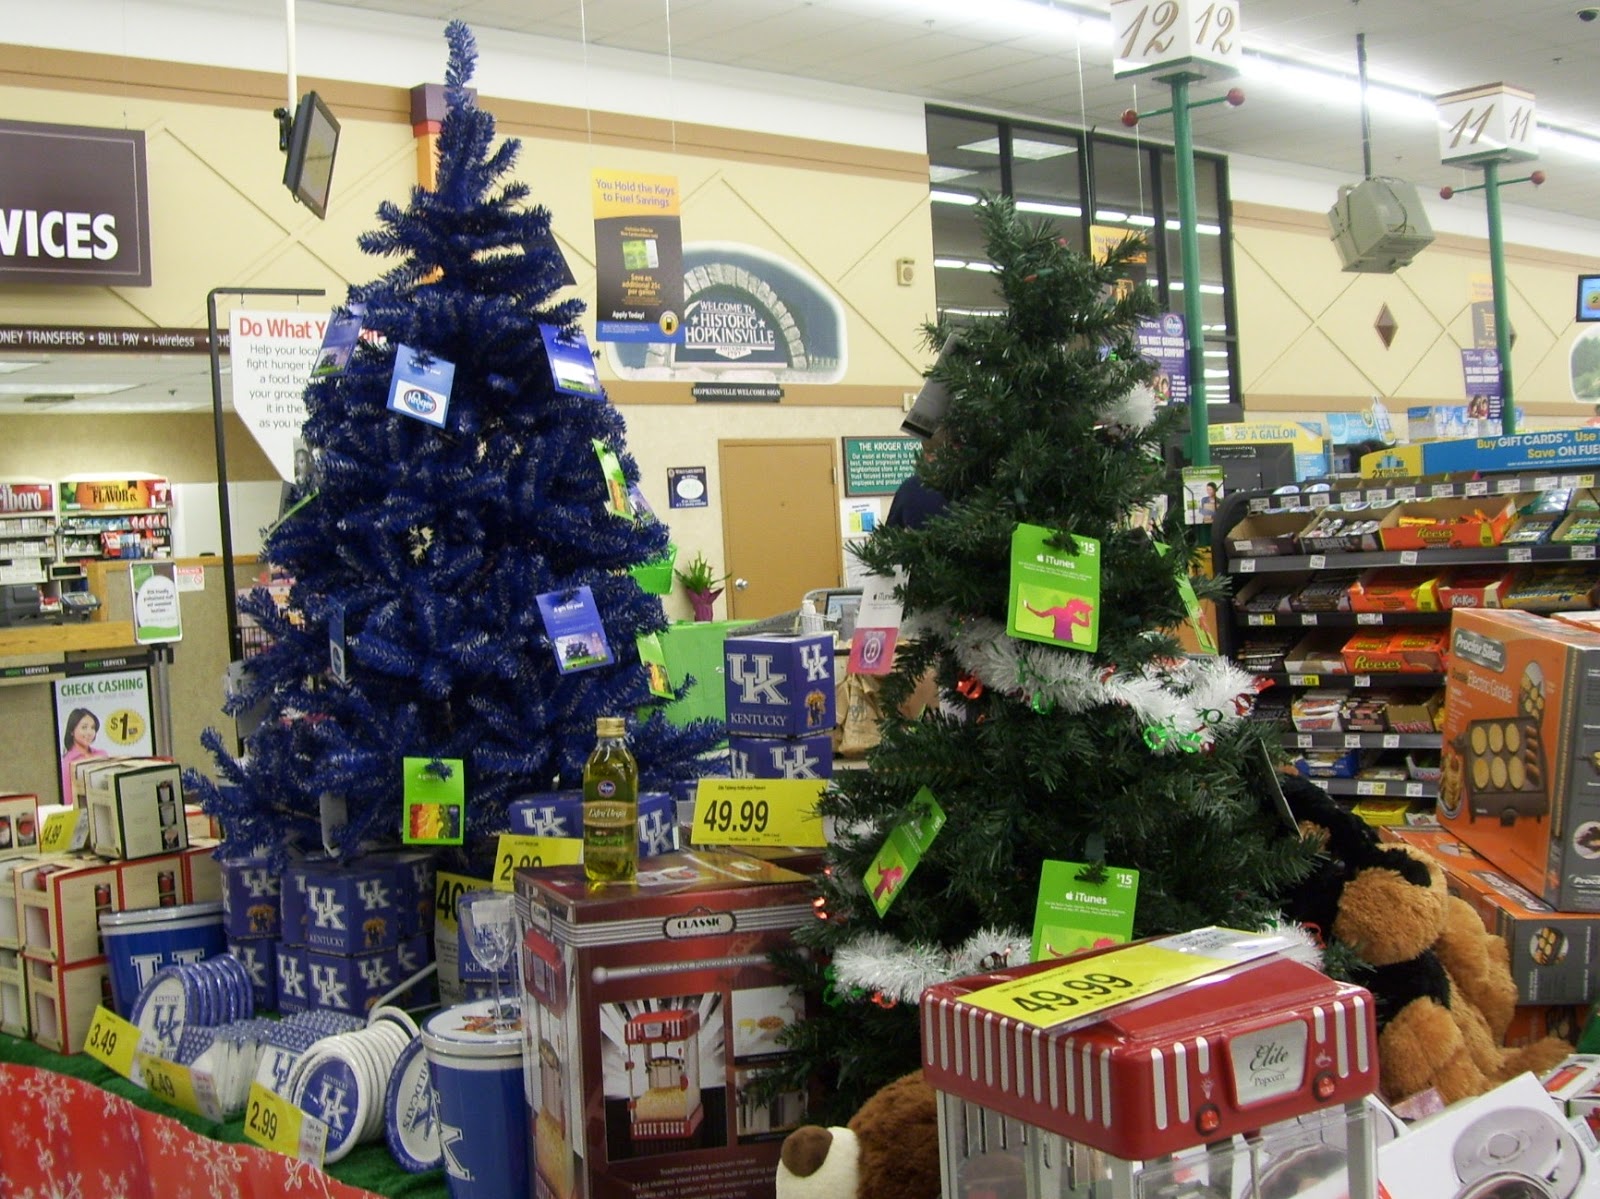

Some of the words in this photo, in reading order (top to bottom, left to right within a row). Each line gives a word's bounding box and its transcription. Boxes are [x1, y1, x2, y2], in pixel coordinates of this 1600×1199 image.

[1121, 0, 1179, 58] 12
[1195, 3, 1235, 54] 12
[1448, 103, 1495, 149] 11
[1509, 106, 1532, 142] 11
[596, 178, 613, 190] You
[614, 180, 635, 192] Hold
[638, 183, 652, 193] the
[655, 184, 674, 197] Keys
[603, 193, 613, 202] to
[615, 193, 634, 203] Fuel
[636, 194, 669, 208] Savings
[612, 311, 627, 320] Apply
[700, 300, 742, 312] WELCOME
[743, 304, 755, 313] TO
[239, 317, 263, 337] Do
[266, 318, 312, 339] What
[700, 313, 758, 329] HISTORIC
[27, 331, 86, 346] TRANSFERS
[98, 332, 120, 346] BILL
[122, 333, 140, 347] PAY
[685, 326, 775, 344] HOPKINSVILLE
[250, 344, 272, 355] Help
[274, 347, 296, 356] your
[246, 359, 268, 370] fight
[271, 359, 305, 371] hunger
[268, 373, 290, 383] food
[249, 389, 271, 400] your
[693, 387, 737, 396] HOPKINSVILLE
[737, 388, 767, 396] WELCOME
[275, 404, 284, 413] in
[286, 405, 303, 414] the
[406, 390, 435, 412] Kroger
[258, 419, 271, 427] as
[273, 420, 291, 430] you
[1259, 428, 1297, 440] GALLON
[1476, 438, 1496, 451] Buy
[1498, 436, 1522, 448] GIFT
[1574, 431, 1596, 443] Use
[859, 442, 872, 451] THE
[873, 442, 901, 451] KROGER
[1526, 448, 1556, 459] Save
[1558, 447, 1578, 457] ON
[1579, 445, 1600, 456] FUE
[92, 488, 129, 504] FLAVOR
[1080, 541, 1096, 553] $15
[1045, 554, 1075, 569] iTunes
[1455, 634, 1482, 655] Proctor
[1482, 642, 1502, 661] Silex
[25, 665, 50, 676] SERVICES
[102, 657, 127, 668] SERVICES
[800, 643, 830, 682] UK
[61, 681, 95, 697] CHECK
[97, 677, 144, 694] CASHING
[727, 652, 791, 706] UK
[730, 712, 787, 727] KENTUCKY
[520, 805, 570, 837] UK
[703, 799, 770, 834] 49.99
[638, 809, 674, 857] UK
[1116, 873, 1134, 885] $15
[356, 879, 391, 910] UK
[1075, 891, 1107, 905] iTunes
[307, 886, 348, 931] UK
[677, 917, 722, 930] CLASSIC
[308, 934, 345, 947] KENTUCKY
[278, 953, 306, 998] UK
[357, 958, 391, 989] UK
[309, 963, 349, 1010] UK
[1010, 972, 1135, 1016] 49.99
[153, 1003, 181, 1048] UK
[90, 1022, 118, 1057] 3.49
[1249, 1043, 1290, 1073] Elite
[146, 1068, 176, 1099] 2.49
[323, 1073, 349, 1090] KENTUCKY
[1254, 1072, 1287, 1089] Popcorn
[320, 1080, 350, 1131] UK
[250, 1100, 278, 1141] 2.99
